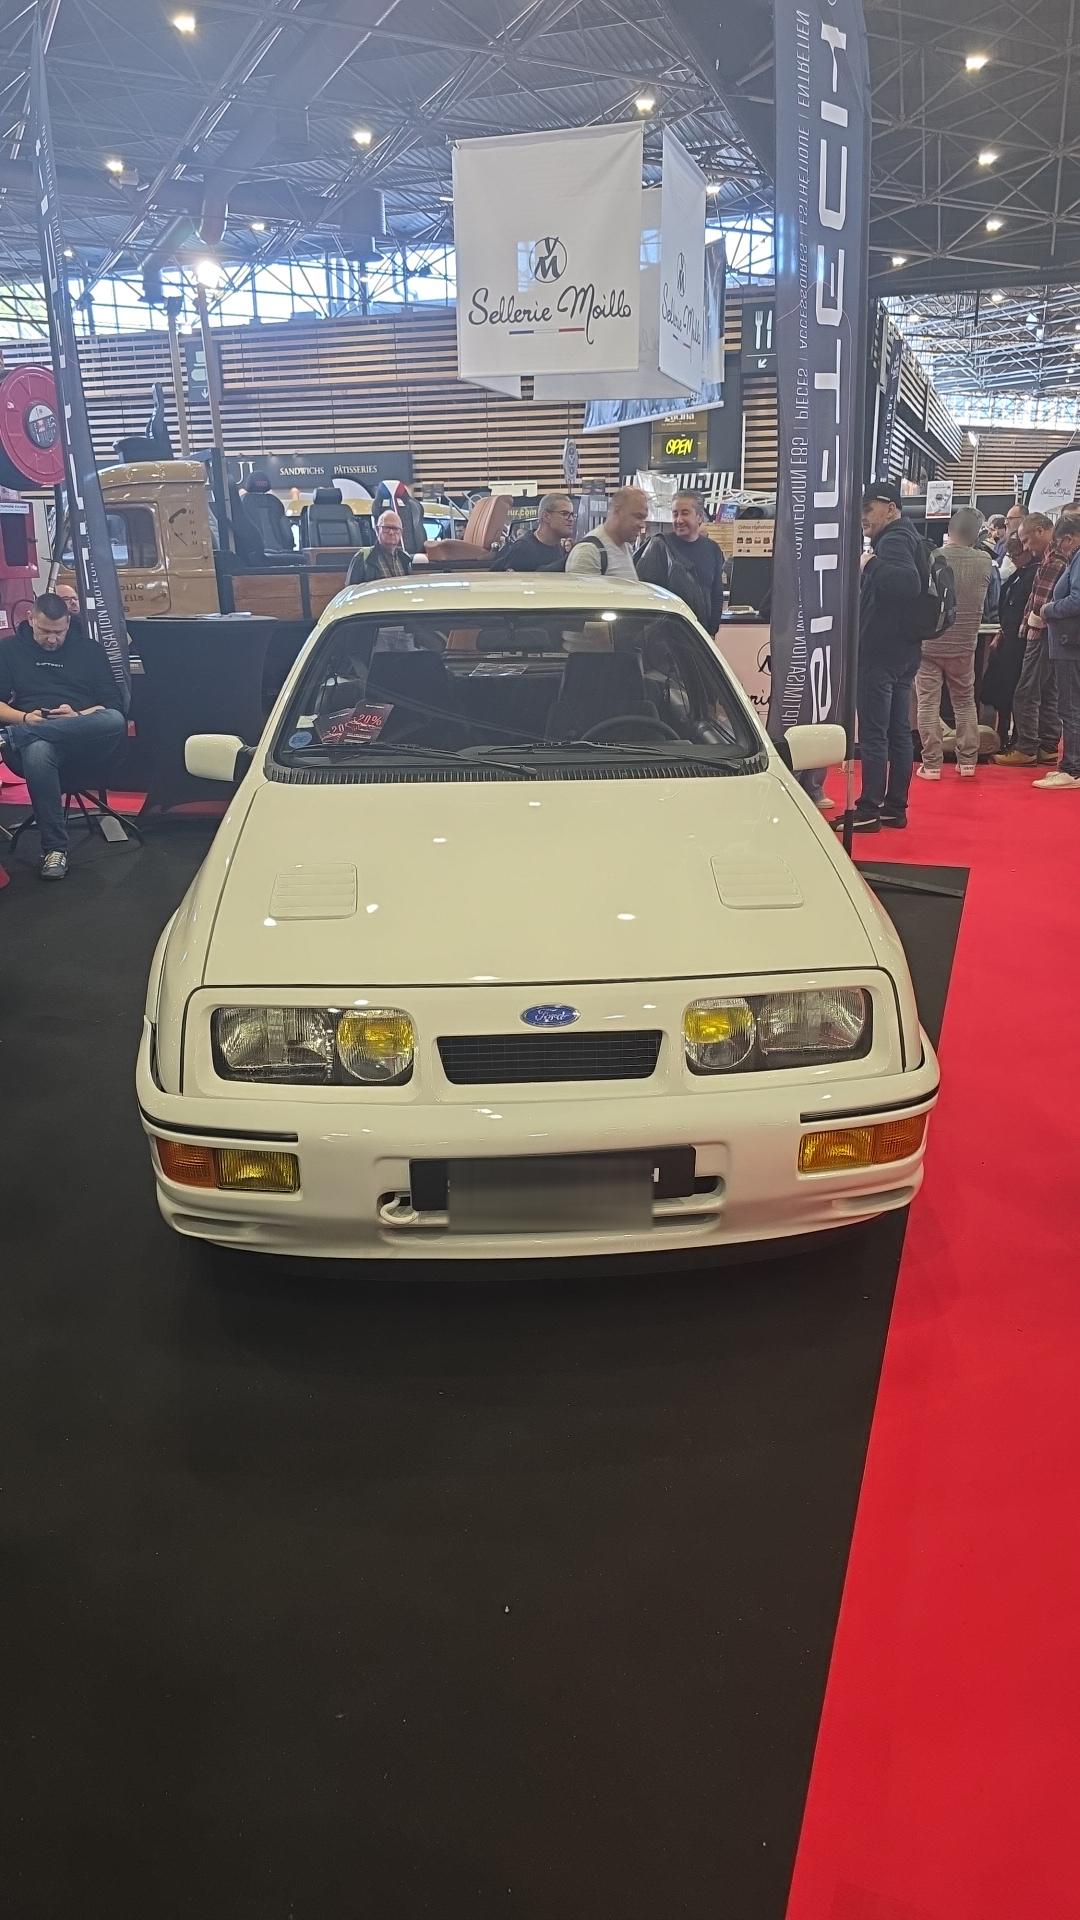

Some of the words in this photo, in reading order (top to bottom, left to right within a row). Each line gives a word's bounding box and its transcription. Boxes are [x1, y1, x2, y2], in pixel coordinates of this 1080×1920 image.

[468, 287, 553, 325] Sellerie
[665, 438, 694, 456] OPEN
[279, 466, 325, 476] SANDWICHS
[534, 1008, 570, 1022] Ford
